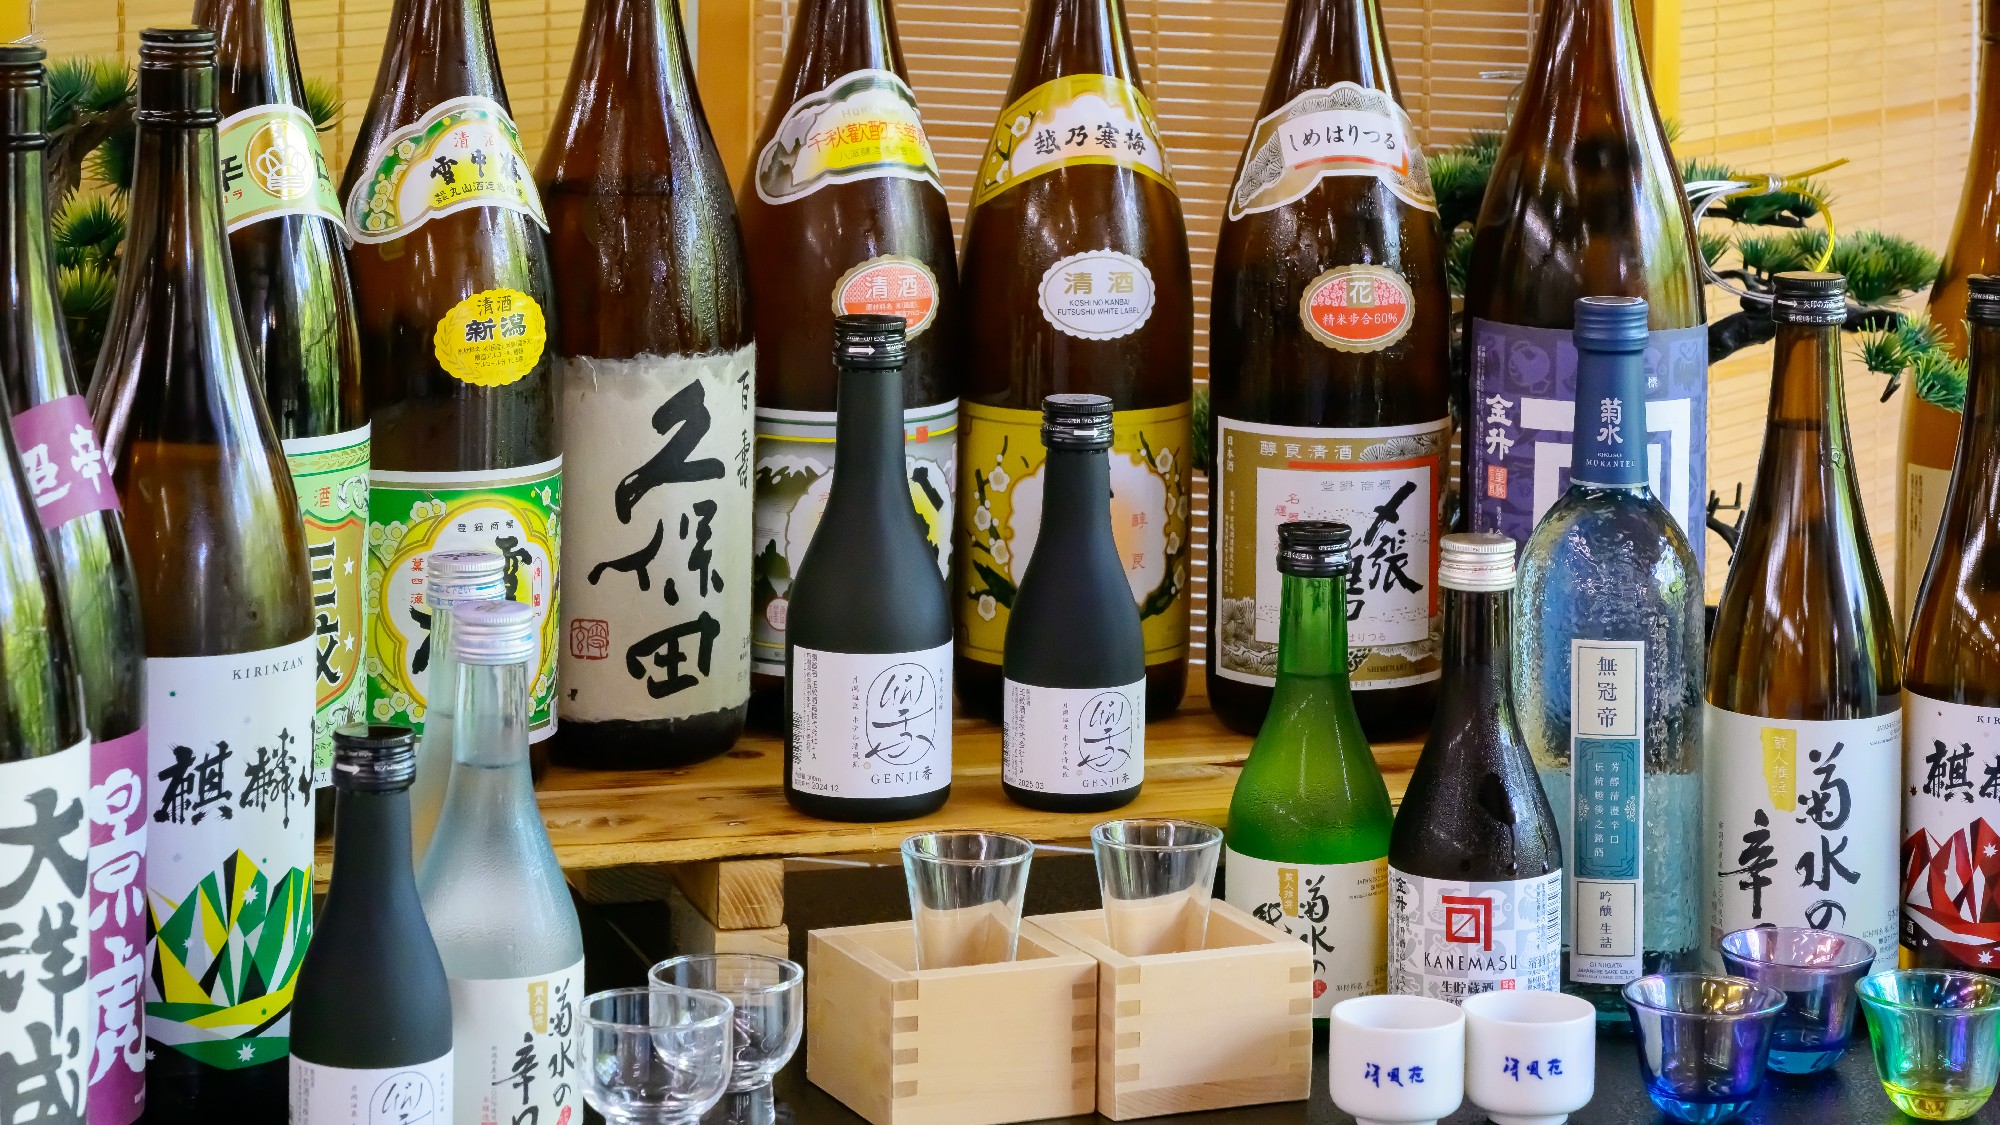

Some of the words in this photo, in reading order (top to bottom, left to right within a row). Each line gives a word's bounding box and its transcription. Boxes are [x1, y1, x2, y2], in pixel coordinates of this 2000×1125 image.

[1034, 121, 1147, 156] 越乃寒梅
[1289, 123, 1396, 152] しめはりつる
[865, 274, 918, 299] 清酒
[1064, 271, 1134, 295] 清酒
[1349, 280, 1372, 305] 花
[477, 294, 512, 316] 清酒
[1057, 308, 1096, 316] FUTSUSHU
[1098, 307, 1119, 315] WHITE
[1104, 298, 1130, 306] KANBAI
[465, 313, 527, 342] 新潟
[1322, 312, 1398, 327] 精米歩合60%
[1597, 397, 1624, 445] 菊水
[587, 379, 726, 699] 久保田
[232, 656, 304, 681] KIRINZAN
[1596, 656, 1618, 728] 無冠帝
[1771, 736, 1789, 798] 蔵人推奨
[1718, 808, 1778, 929] 辛
[1600, 890, 1613, 949] 吟醸生詰
[1424, 952, 1517, 971] KANEMASU
[1441, 980, 1494, 994] 生貯蔵酒
